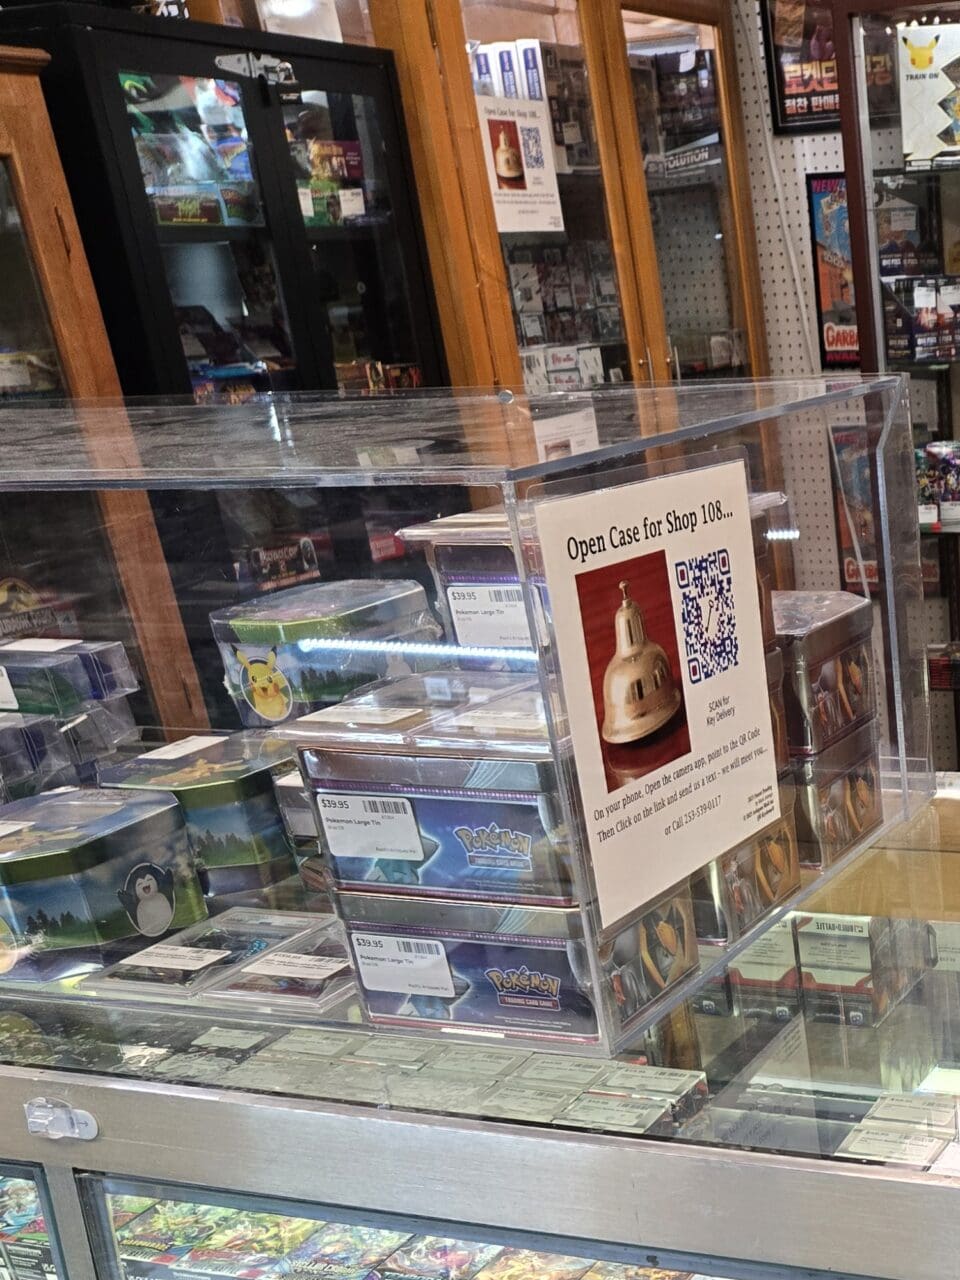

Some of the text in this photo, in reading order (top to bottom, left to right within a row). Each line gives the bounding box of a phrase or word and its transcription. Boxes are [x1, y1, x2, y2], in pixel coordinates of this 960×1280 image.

[905, 73, 927, 81] TRAIN
[566, 499, 733, 563] Open Case for Shop 108...
[451, 591, 477, 601] $39.95
[481, 609, 495, 617] Large
[708, 695, 731, 713] SCAN for
[706, 705, 735, 727] Key Delivery
[593, 807, 605, 821] On
[605, 799, 621, 817] your
[644, 777, 661, 798] Open
[661, 773, 672, 786] the
[672, 763, 693, 785] camera
[707, 748, 722, 766] point
[723, 745, 729, 756] to
[729, 739, 738, 752] the
[738, 733, 747, 747] QR
[747, 726, 761, 741] Code
[320, 798, 350, 810] $39.95
[597, 826, 615, 843] Then
[615, 815, 633, 834] Click
[633, 811, 642, 824] on
[642, 803, 653, 819] the
[653, 796, 666, 814] link
[666, 789, 678, 808] and
[678, 785, 693, 802] send
[693, 779, 701, 792] us
[701, 777, 706, 786] a
[706, 770, 717, 785] text
[730, 758, 740, 773] will
[740, 752, 753, 769] meet
[664, 794, 722, 836] or Call 253-539-0117
[453, 822, 532, 857] Pokémon
[355, 936, 384, 949] $39.95
[485, 966, 561, 999] Pokémon
